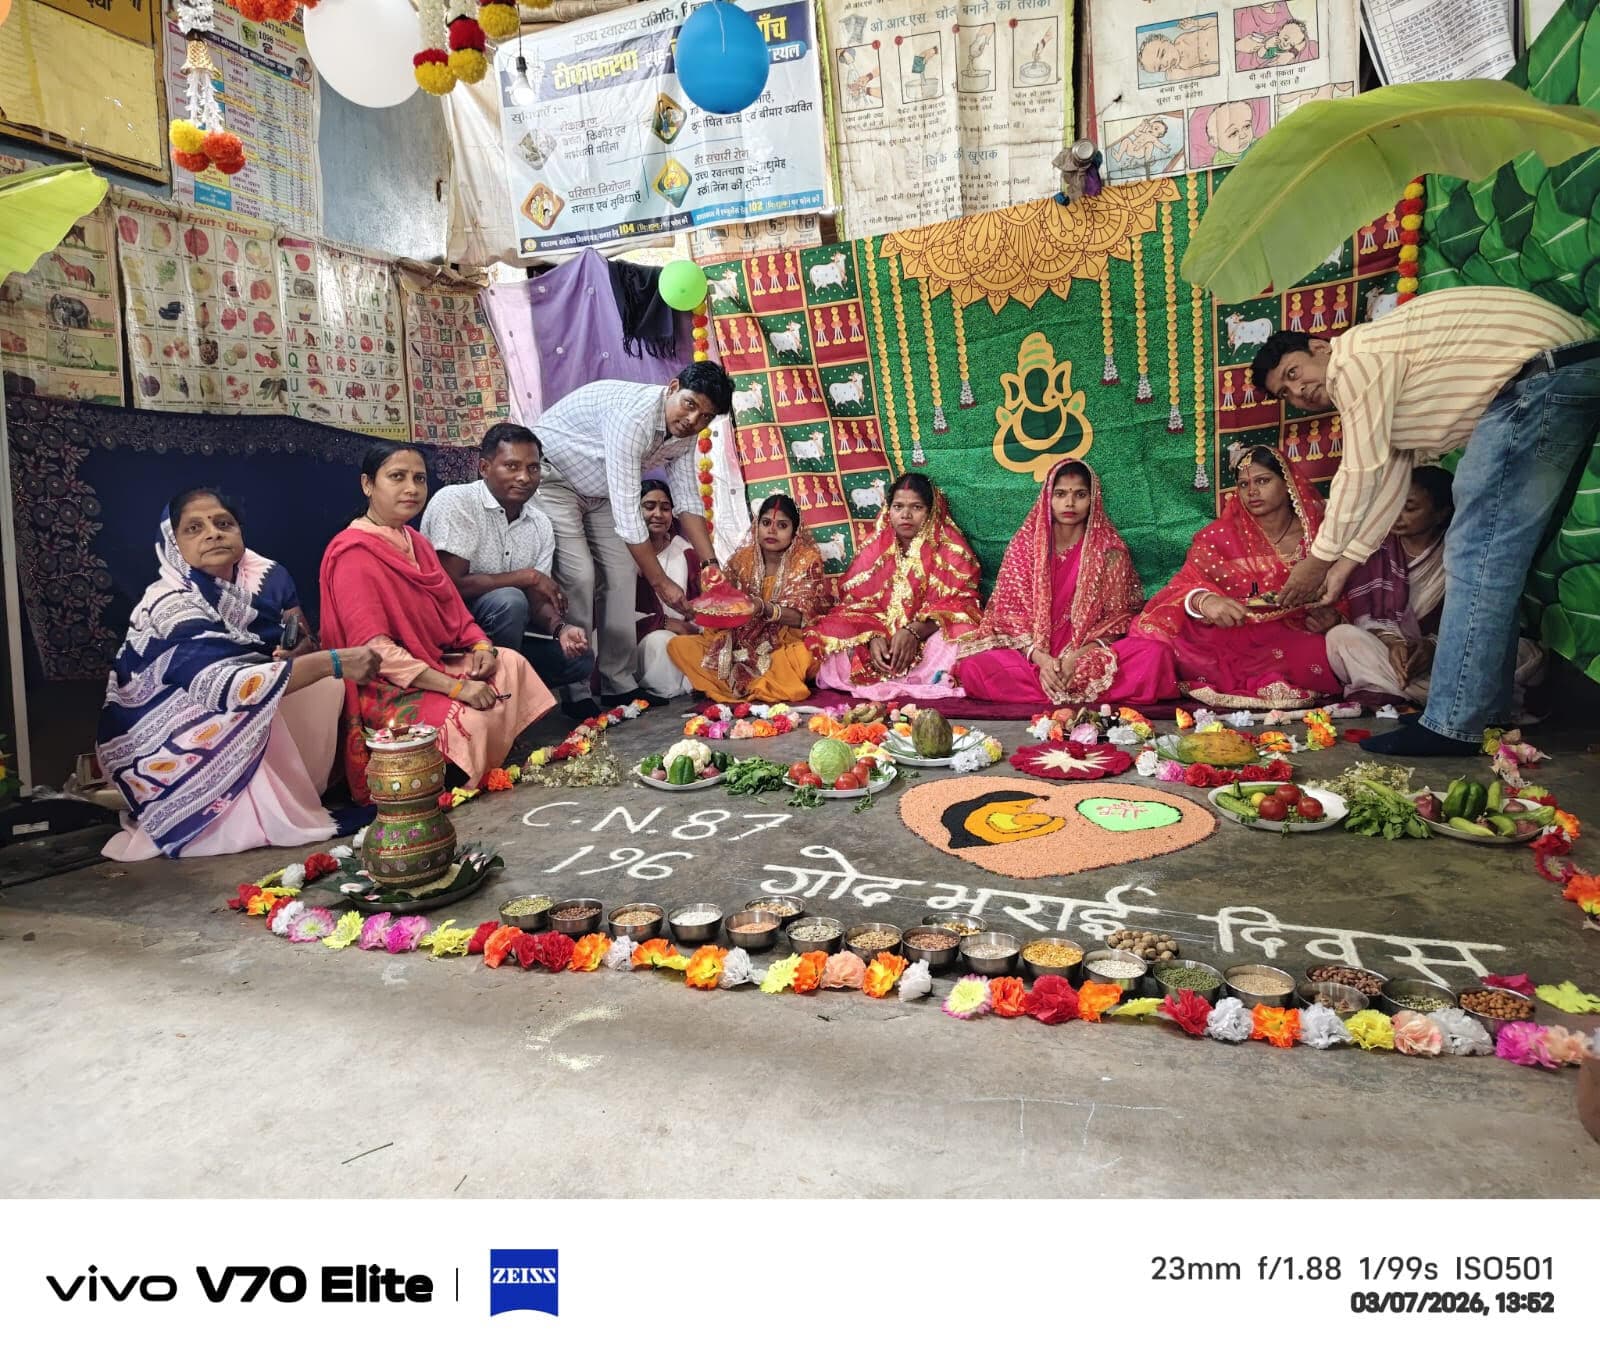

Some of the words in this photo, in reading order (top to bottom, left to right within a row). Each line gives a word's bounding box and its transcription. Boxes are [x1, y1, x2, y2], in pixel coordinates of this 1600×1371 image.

[640, 7, 679, 29] समिति,
[553, 50, 639, 91] टीकाकरण
[967, 149, 998, 166] खुराक
[567, 186, 597, 199] परिवार
[571, 202, 595, 214] सलाह
[748, 200, 763, 212] 102
[226, 220, 259, 237] Chart
[619, 223, 635, 236] 104
[287, 326, 297, 342] M
[324, 331, 332, 345] N
[348, 335, 356, 349] O
[288, 352, 299, 368] Q
[326, 355, 334, 370] R
[349, 358, 357, 373] S
[290, 378, 299, 392] U
[370, 383, 381, 397] W
[291, 402, 301, 417] X
[541, 845, 697, 880] 196
[760, 845, 927, 908] गोद
[926, 883, 1160, 941] भराई
[1197, 906, 1507, 987] दिवस
